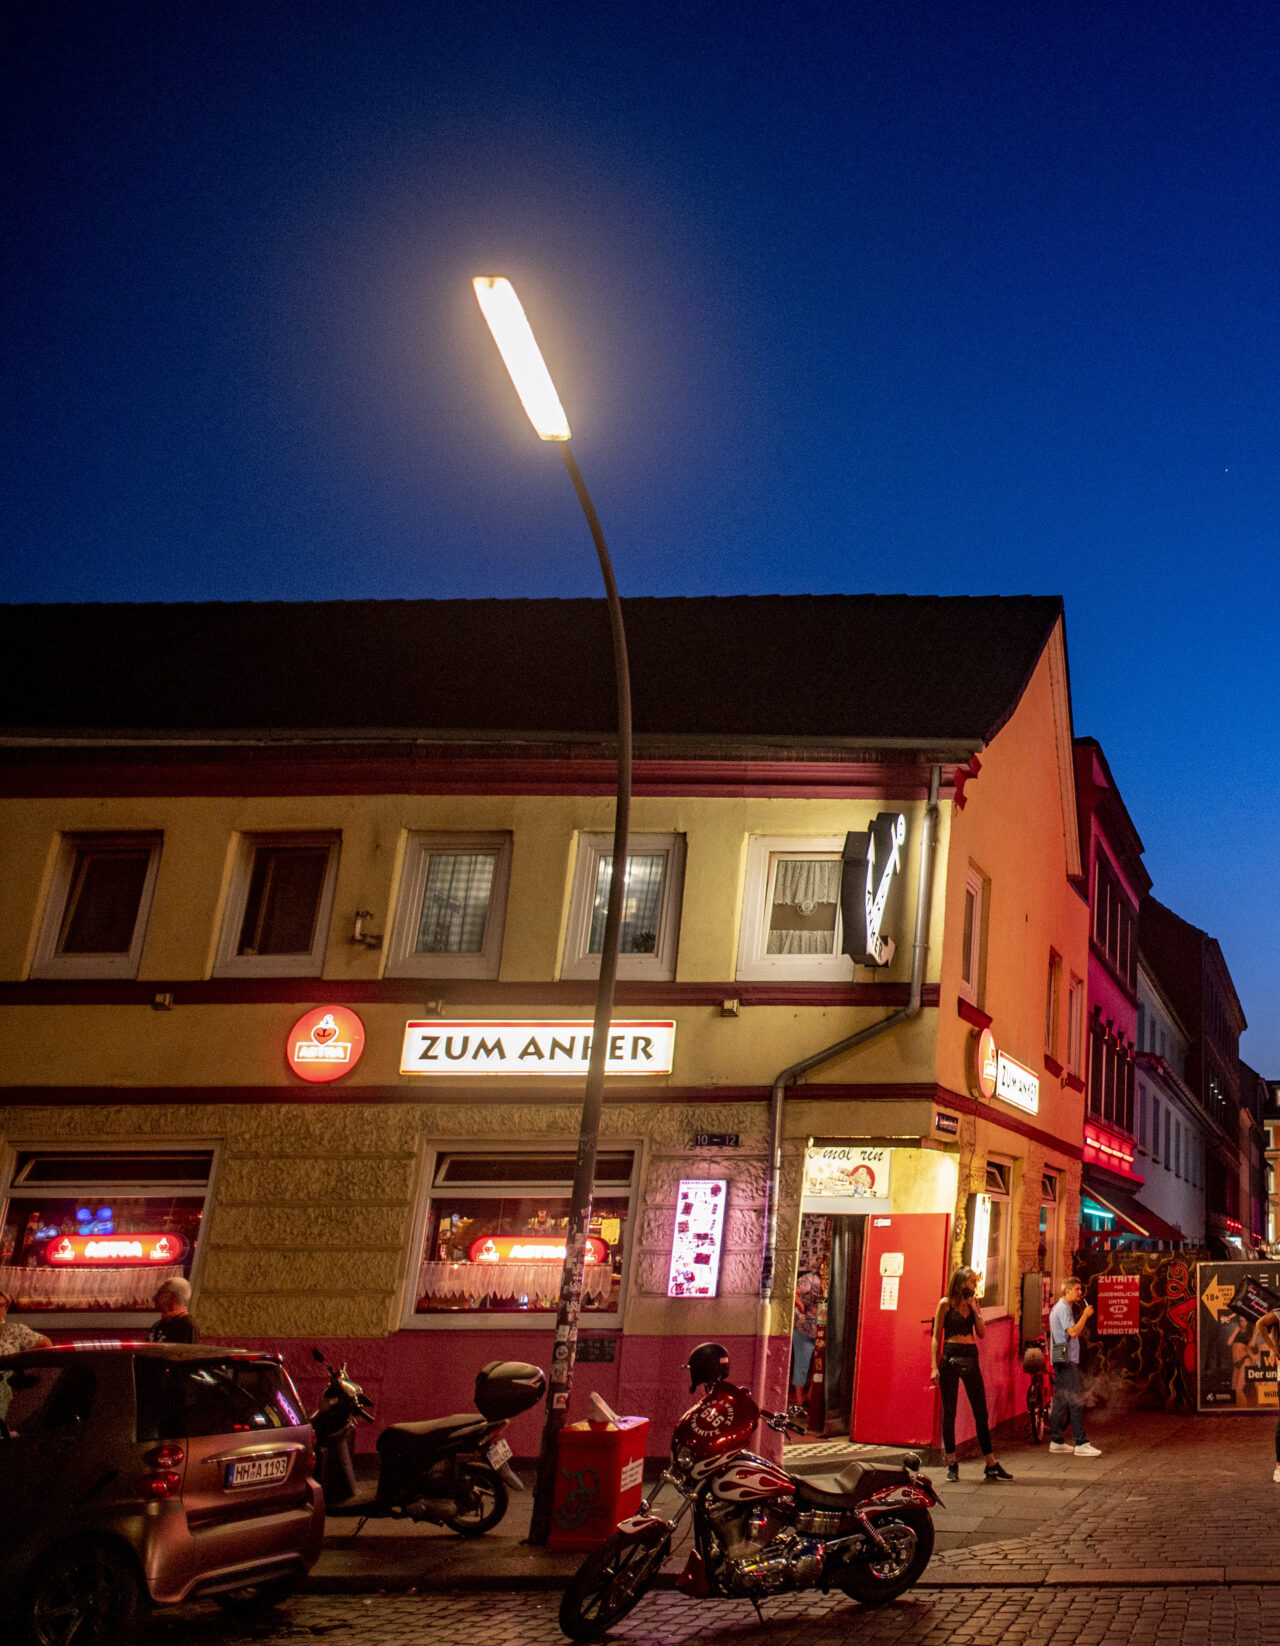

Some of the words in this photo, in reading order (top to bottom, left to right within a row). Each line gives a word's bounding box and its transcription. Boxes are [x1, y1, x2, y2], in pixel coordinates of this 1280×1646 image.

[418, 1035, 507, 1061] ZUM
[1098, 1275, 1140, 1284] ZUTRITT
[1205, 1294, 1219, 1302] 18+
[1247, 1369, 1264, 1379] Der
[700, 1407, 725, 1428] 666
[235, 1463, 250, 1481] HH
[264, 1459, 287, 1477] 1193
